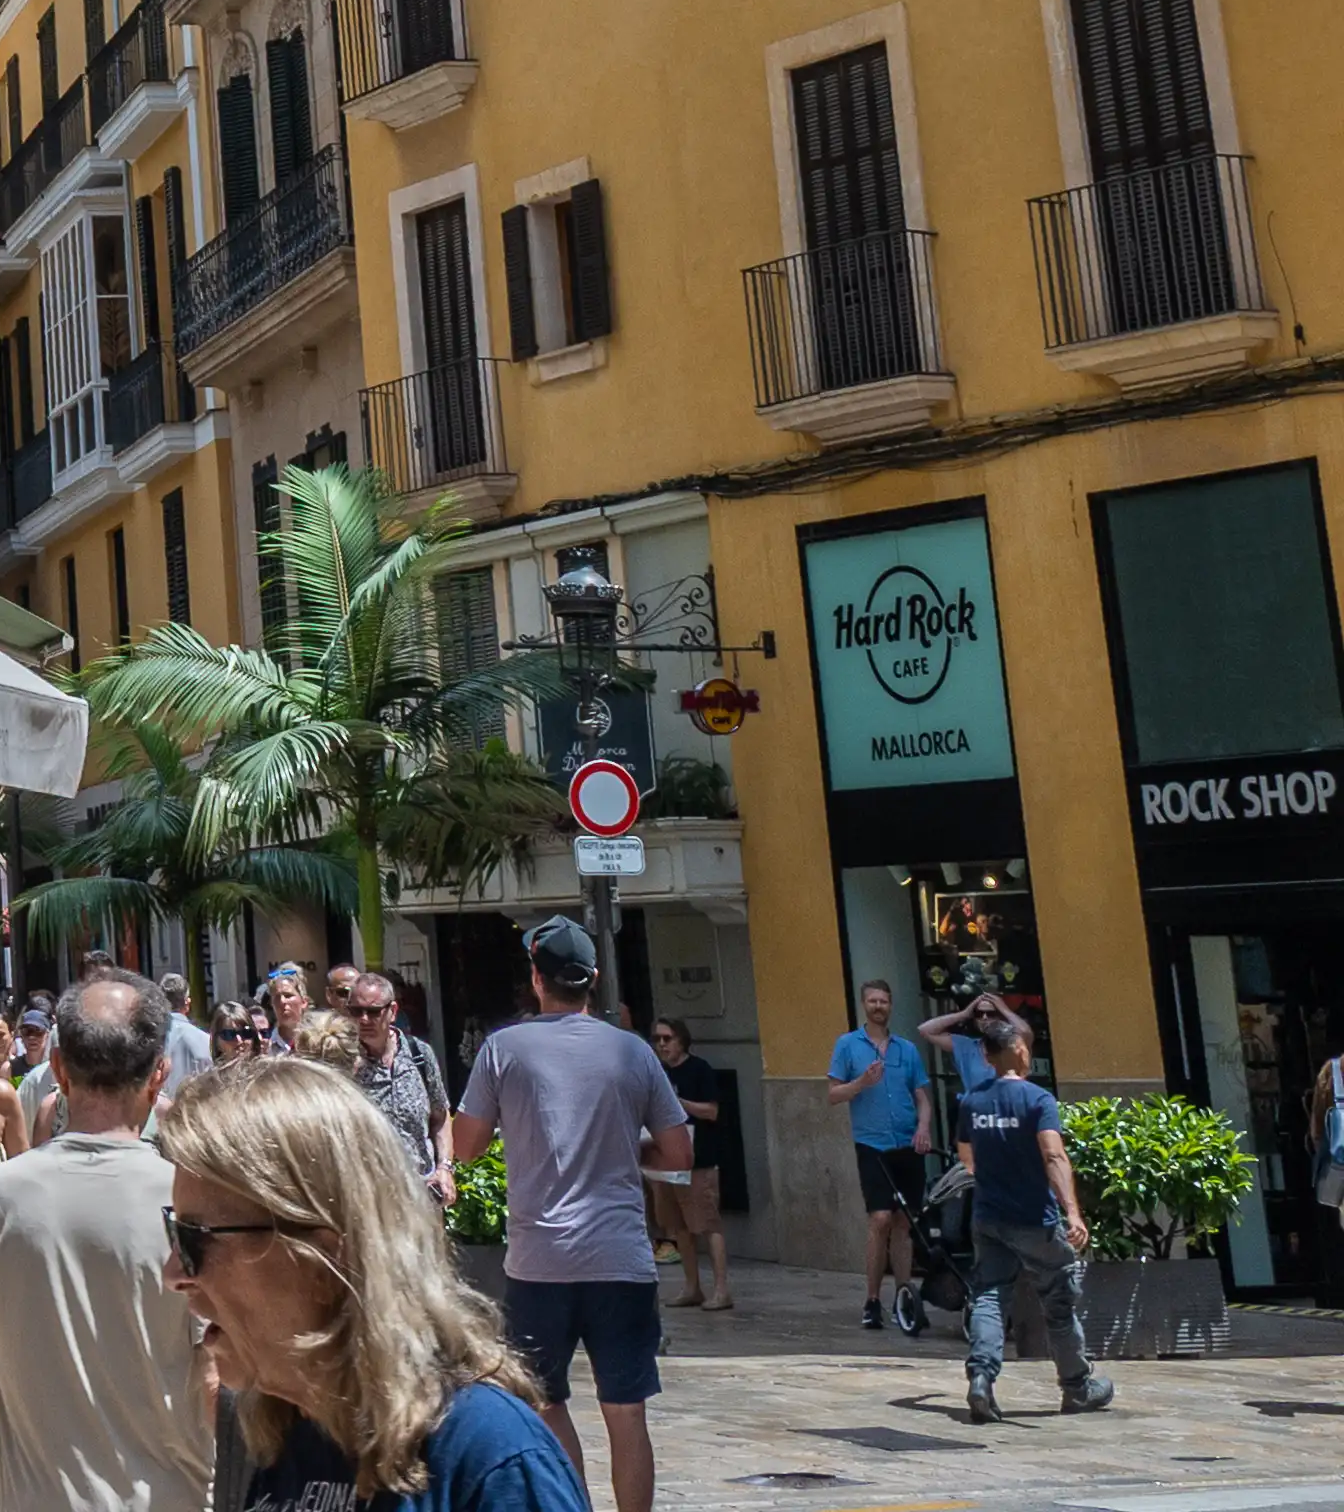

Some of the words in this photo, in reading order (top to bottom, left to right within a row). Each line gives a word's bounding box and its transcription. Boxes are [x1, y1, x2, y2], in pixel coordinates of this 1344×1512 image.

[833, 596, 902, 650] Hard
[906, 587, 978, 649] Rock
[892, 657, 930, 679] CAFE
[871, 728, 971, 762] MALLORCA
[1140, 777, 1236, 826] ROCK
[1240, 770, 1337, 819] SHOP
